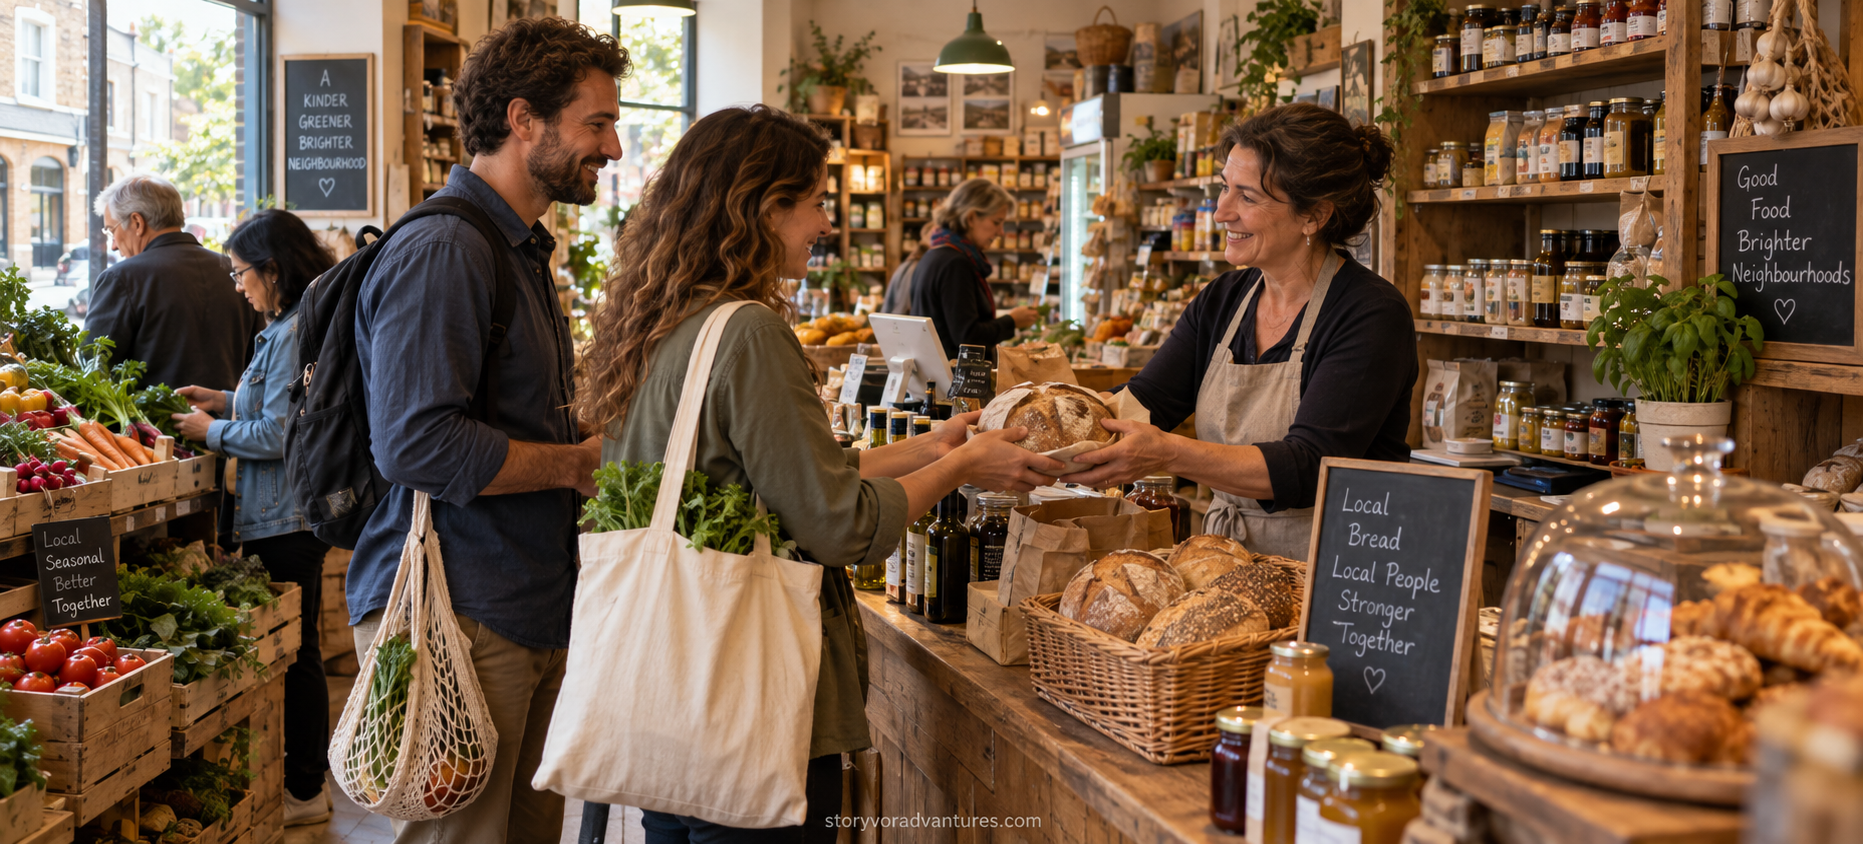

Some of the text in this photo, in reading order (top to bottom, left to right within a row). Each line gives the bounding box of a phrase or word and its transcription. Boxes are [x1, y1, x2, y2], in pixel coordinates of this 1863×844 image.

[319, 69, 331, 87] A
[303, 93, 349, 108] KINDER
[298, 114, 353, 130] GREENER
[298, 135, 353, 150] BRIGHTER
[288, 157, 367, 170] NEIGHBOURHOOD
[1737, 163, 1778, 192] Good
[1750, 195, 1791, 220] Food
[1737, 229, 1812, 261] Brighter
[1732, 260, 1851, 292] Neighbourhoods
[1342, 487, 1390, 516] Local
[43, 527, 82, 548] Local
[1348, 522, 1402, 550] Bread
[45, 547, 105, 571] Seasonal
[53, 574, 97, 592] Better
[1332, 555, 1441, 600] Local People
[51, 593, 112, 619] Together
[1338, 588, 1415, 629] Stronger
[1332, 620, 1415, 658] Together
